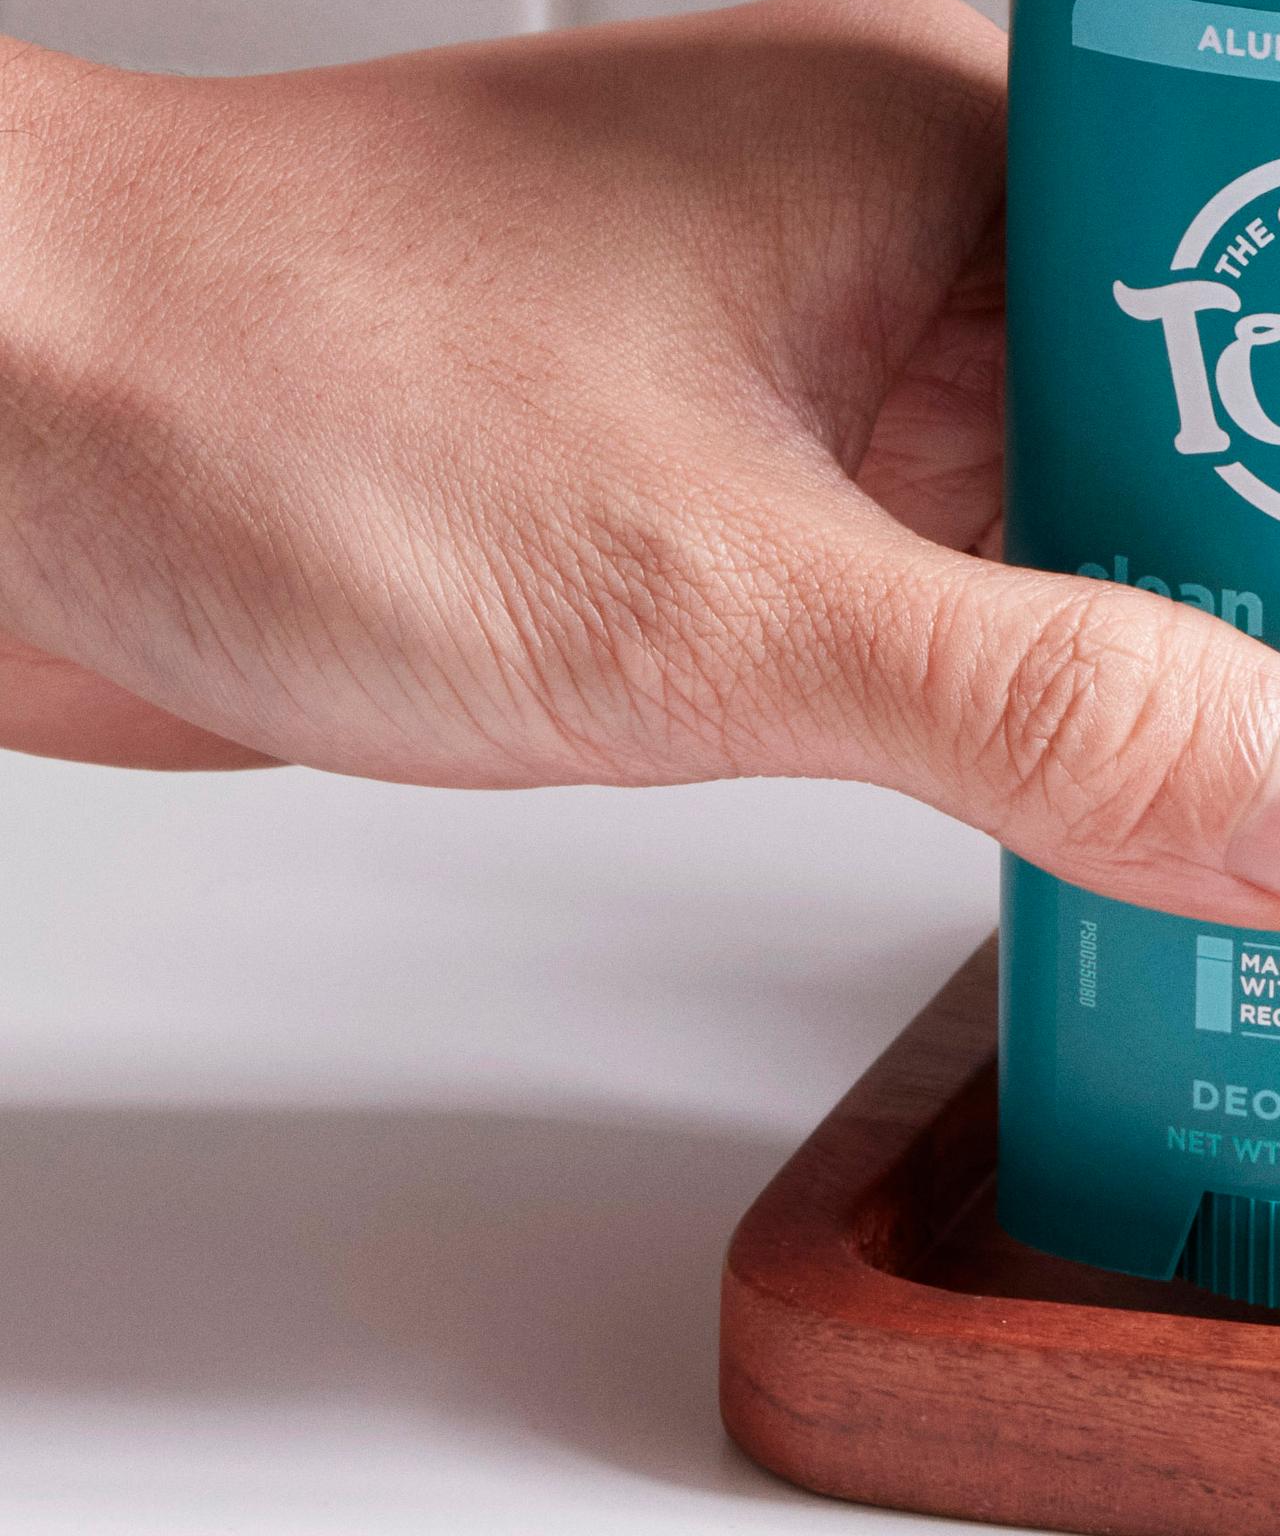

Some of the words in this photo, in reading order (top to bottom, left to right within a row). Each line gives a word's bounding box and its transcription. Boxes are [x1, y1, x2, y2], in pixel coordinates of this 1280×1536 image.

[1214, 217, 1275, 279] THE
[1167, 1125, 1223, 1157] NET
[1232, 1135, 1280, 1164] WT
